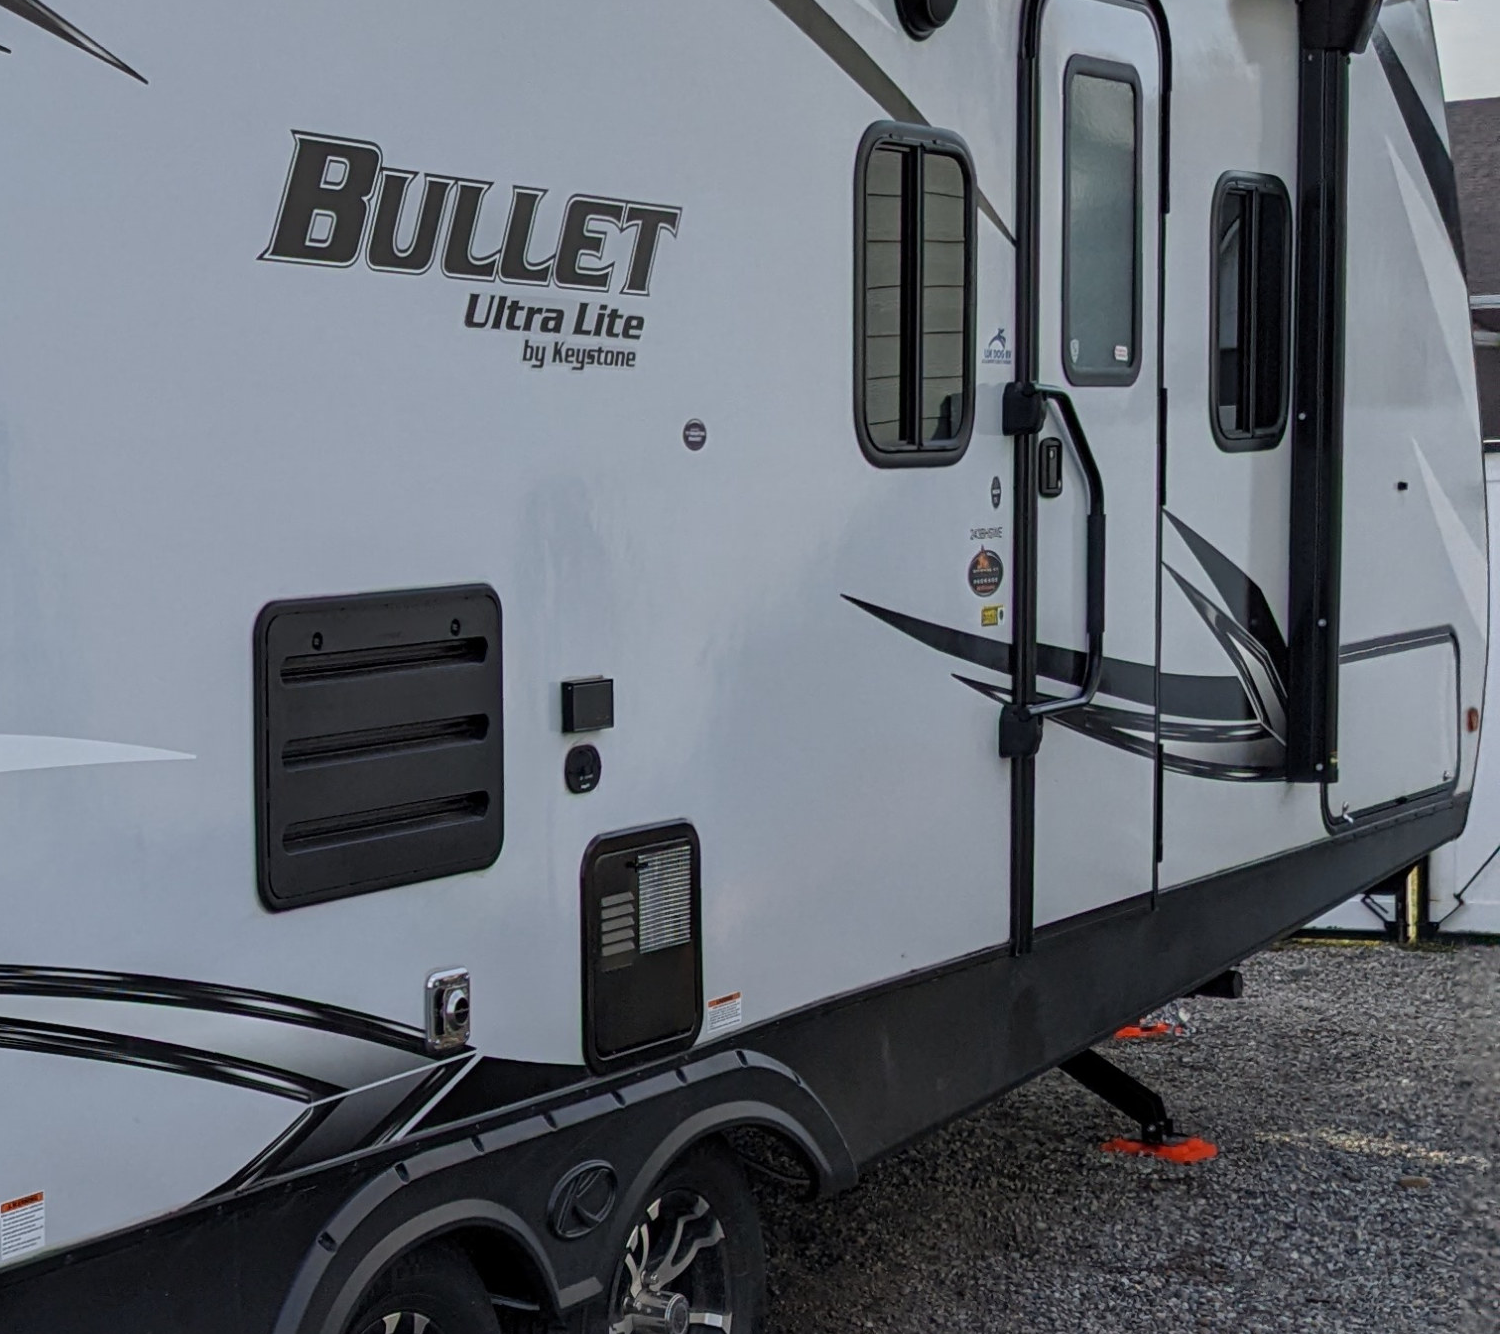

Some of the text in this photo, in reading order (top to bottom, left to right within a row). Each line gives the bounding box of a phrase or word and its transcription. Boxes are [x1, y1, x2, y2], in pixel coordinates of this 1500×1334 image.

[257, 129, 683, 296] BULLET
[464, 293, 645, 340] Ultra Lite
[522, 340, 636, 370] by Keystone
